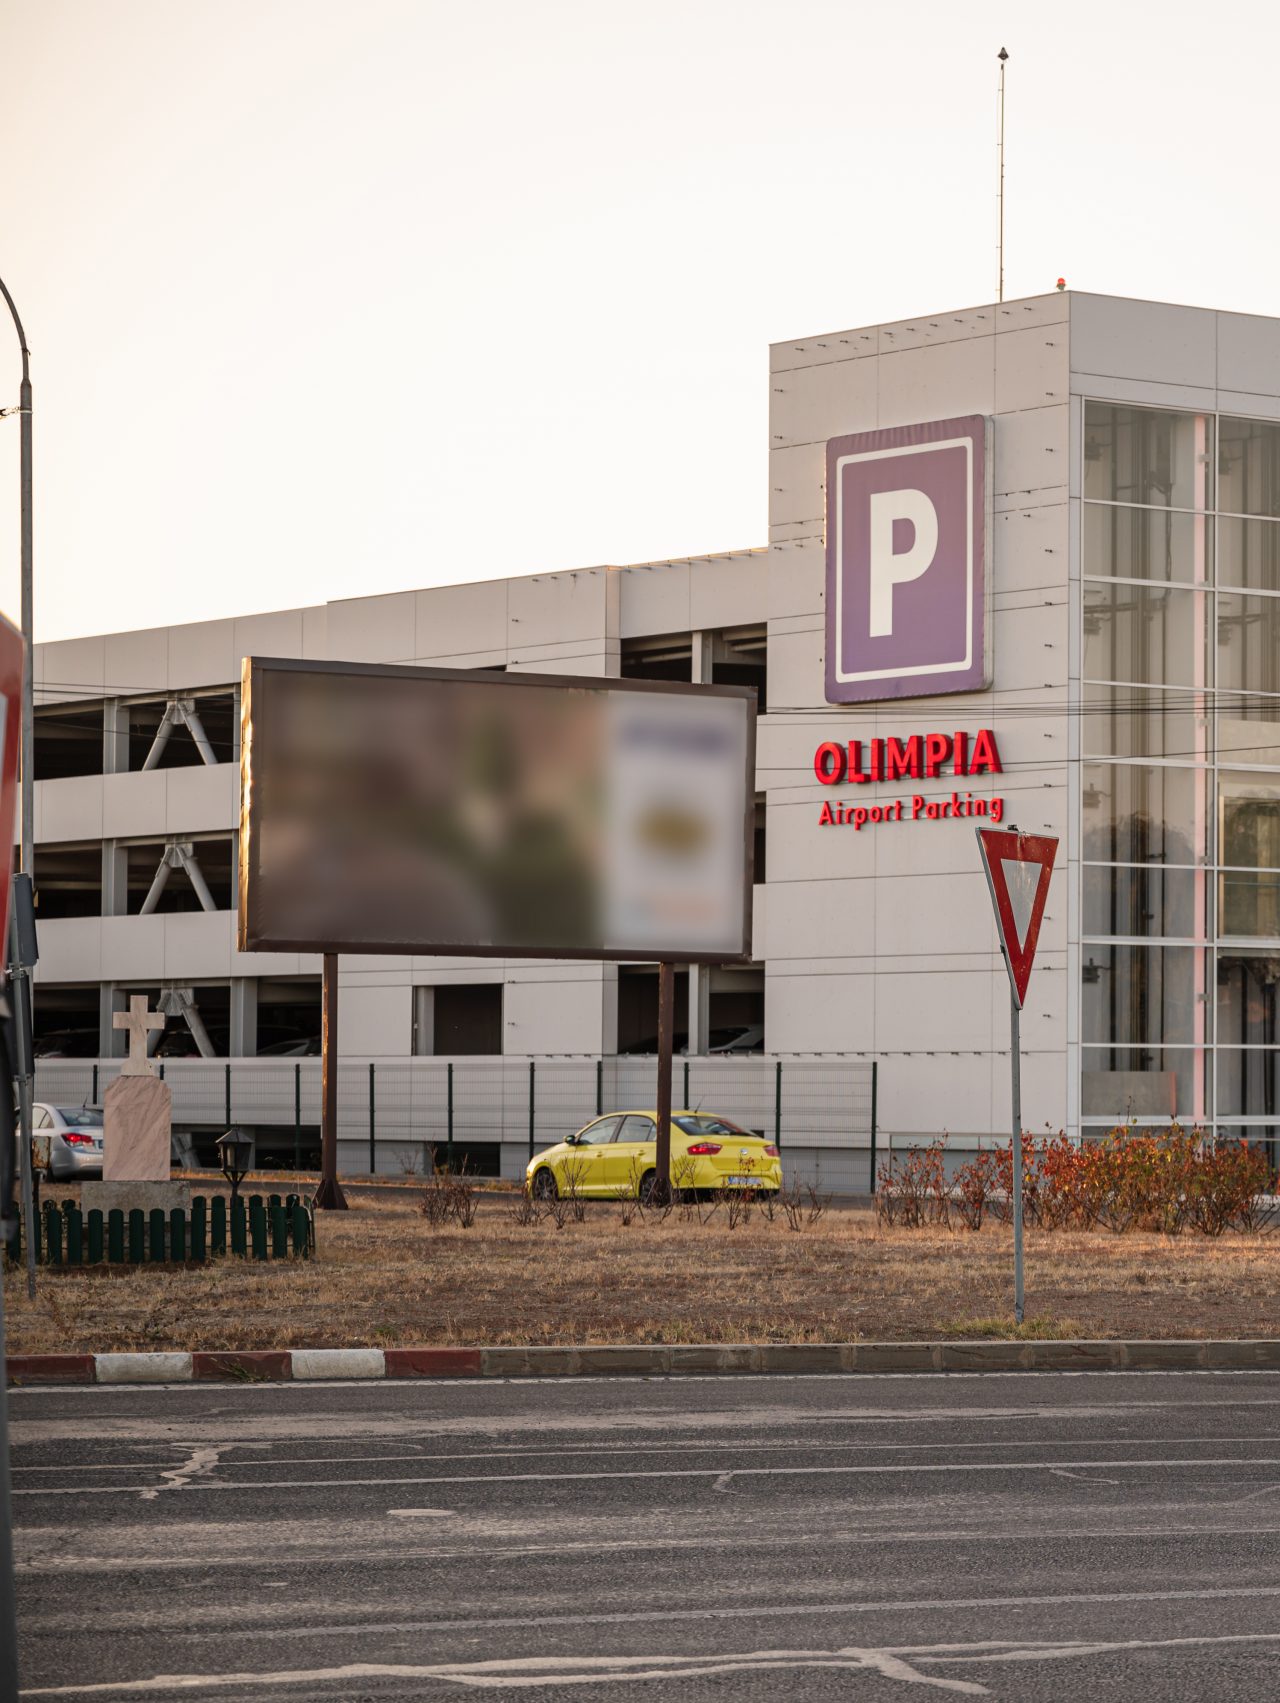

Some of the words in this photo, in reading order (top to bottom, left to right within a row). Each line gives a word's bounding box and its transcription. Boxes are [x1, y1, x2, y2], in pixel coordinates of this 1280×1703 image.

[869, 488, 939, 638] P
[813, 729, 1003, 785] OLIMPIA
[818, 799, 902, 831] Airport
[912, 792, 1004, 823] Parking
